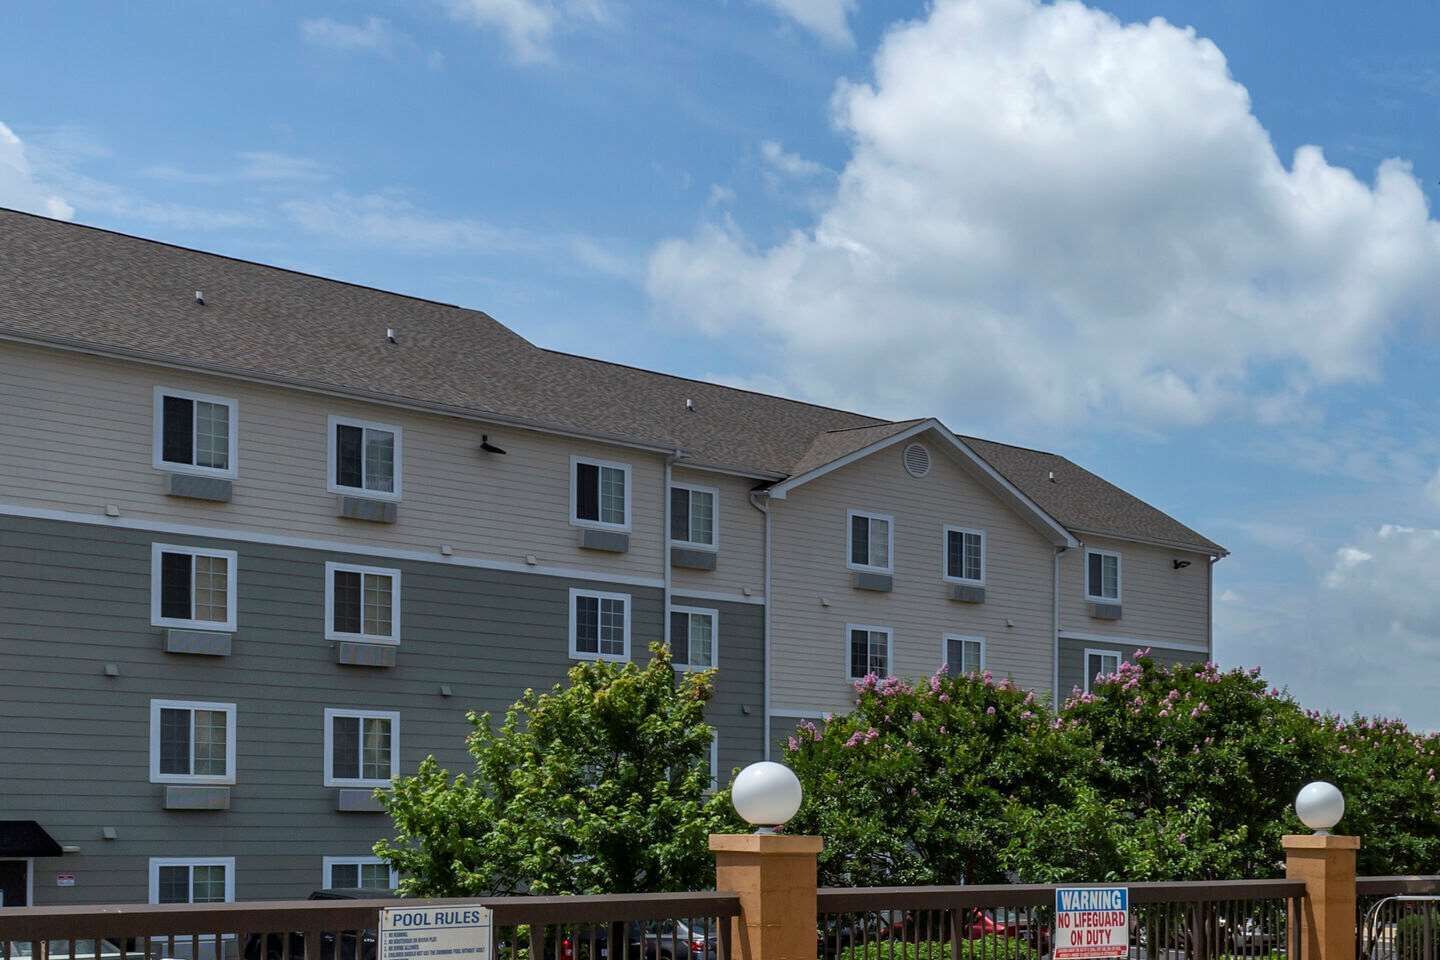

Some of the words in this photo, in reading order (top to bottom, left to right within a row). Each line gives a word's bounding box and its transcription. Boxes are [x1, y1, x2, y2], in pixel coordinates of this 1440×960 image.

[1061, 890, 1122, 910] WARNING
[393, 913, 431, 926] POOL
[435, 911, 480, 925] RULES
[1058, 912, 1070, 928] NO
[1074, 911, 1125, 928] LIFEGUARD
[1070, 930, 1083, 946] ON
[1086, 929, 1112, 945] DUTY
